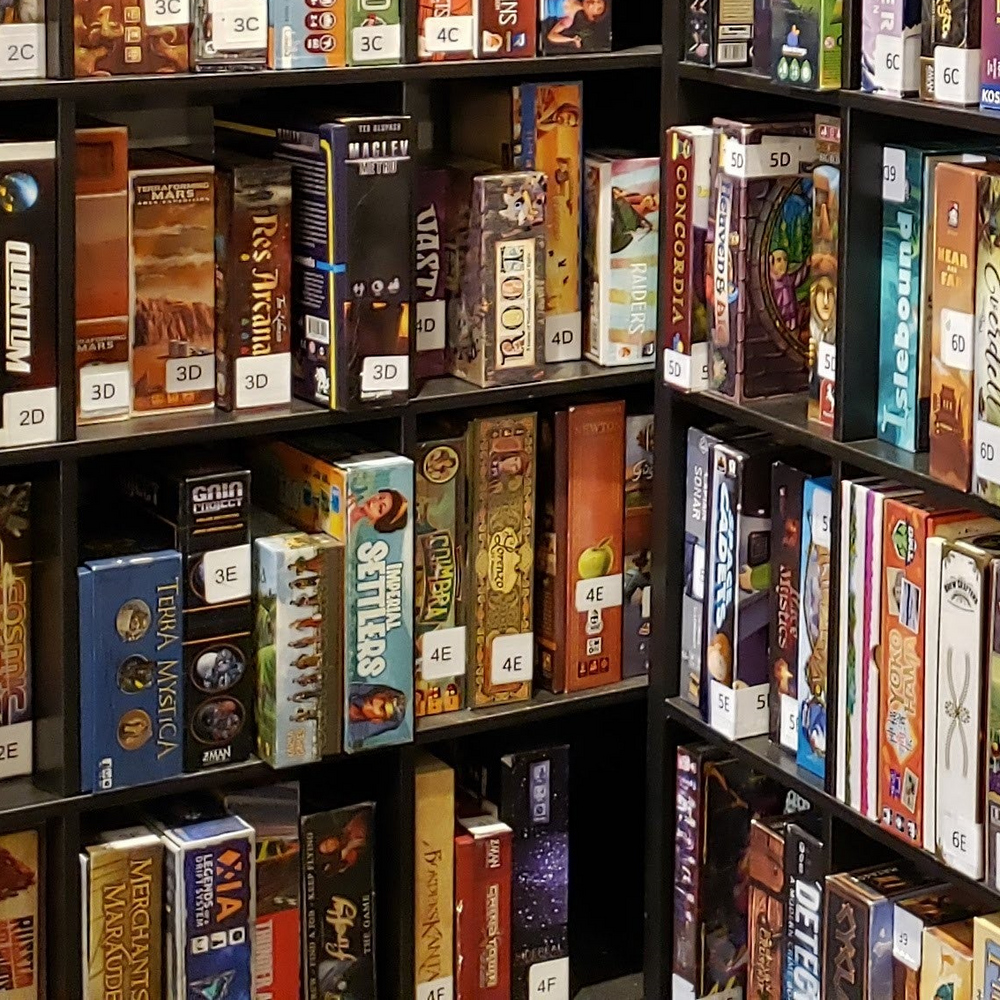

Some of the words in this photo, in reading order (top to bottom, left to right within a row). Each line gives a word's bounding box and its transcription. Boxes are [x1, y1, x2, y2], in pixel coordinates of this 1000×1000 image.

[234, 17, 260, 32] 3C
[361, 36, 382, 51] 3C
[437, 27, 459, 42] 4C
[8, 44, 35, 61] 2C
[886, 53, 899, 70] 6C
[944, 67, 960, 85] 6C
[349, 139, 409, 159] MAGLEV
[358, 161, 398, 175] METRO
[731, 151, 744, 167] 5D
[770, 151, 791, 167] 5D
[137, 181, 209, 194] TERRAFORMING
[151, 188, 195, 201] MARS
[251, 213, 279, 263] Res
[670, 163, 689, 324] CONCORDIA
[415, 203, 441, 298] VAST
[937, 248, 969, 270] NEAR
[4, 239, 31, 373] QUANTUM
[499, 245, 527, 367] ROOT
[628, 262, 647, 335] RAIDERS
[251, 267, 280, 357] Arcana
[882, 212, 914, 434] Islebound
[77, 340, 114, 352] MARS
[552, 330, 573, 344] 4D
[952, 334, 965, 352] 6D
[176, 364, 202, 381] 3D
[373, 365, 397, 380] 3D
[669, 359, 681, 377] 5D
[245, 374, 268, 390] 3D
[92, 383, 115, 400] 3D
[19, 409, 45, 426] 2D
[981, 442, 994, 460] 6D
[191, 480, 243, 502] GAIA
[691, 464, 702, 528] SONAR
[714, 481, 730, 630] CADETS
[215, 566, 237, 583] 3E
[423, 533, 452, 622] COIMBRA
[384, 562, 403, 631] IMPERIAL
[586, 586, 604, 602] 4E
[155, 577, 180, 651] TERRA
[356, 540, 391, 678] SETTLERS
[431, 646, 451, 662] 4E
[502, 656, 523, 672] 4E
[156, 659, 181, 760] MYSTICA
[718, 693, 730, 712] 5E
[202, 745, 232, 763] ZMAN
[952, 831, 966, 852] 6E
[203, 853, 214, 909] LEGENDS
[129, 858, 153, 1000] MERCHANTS
[486, 884, 500, 988] CHINATOWN
[538, 977, 557, 993] 4F
